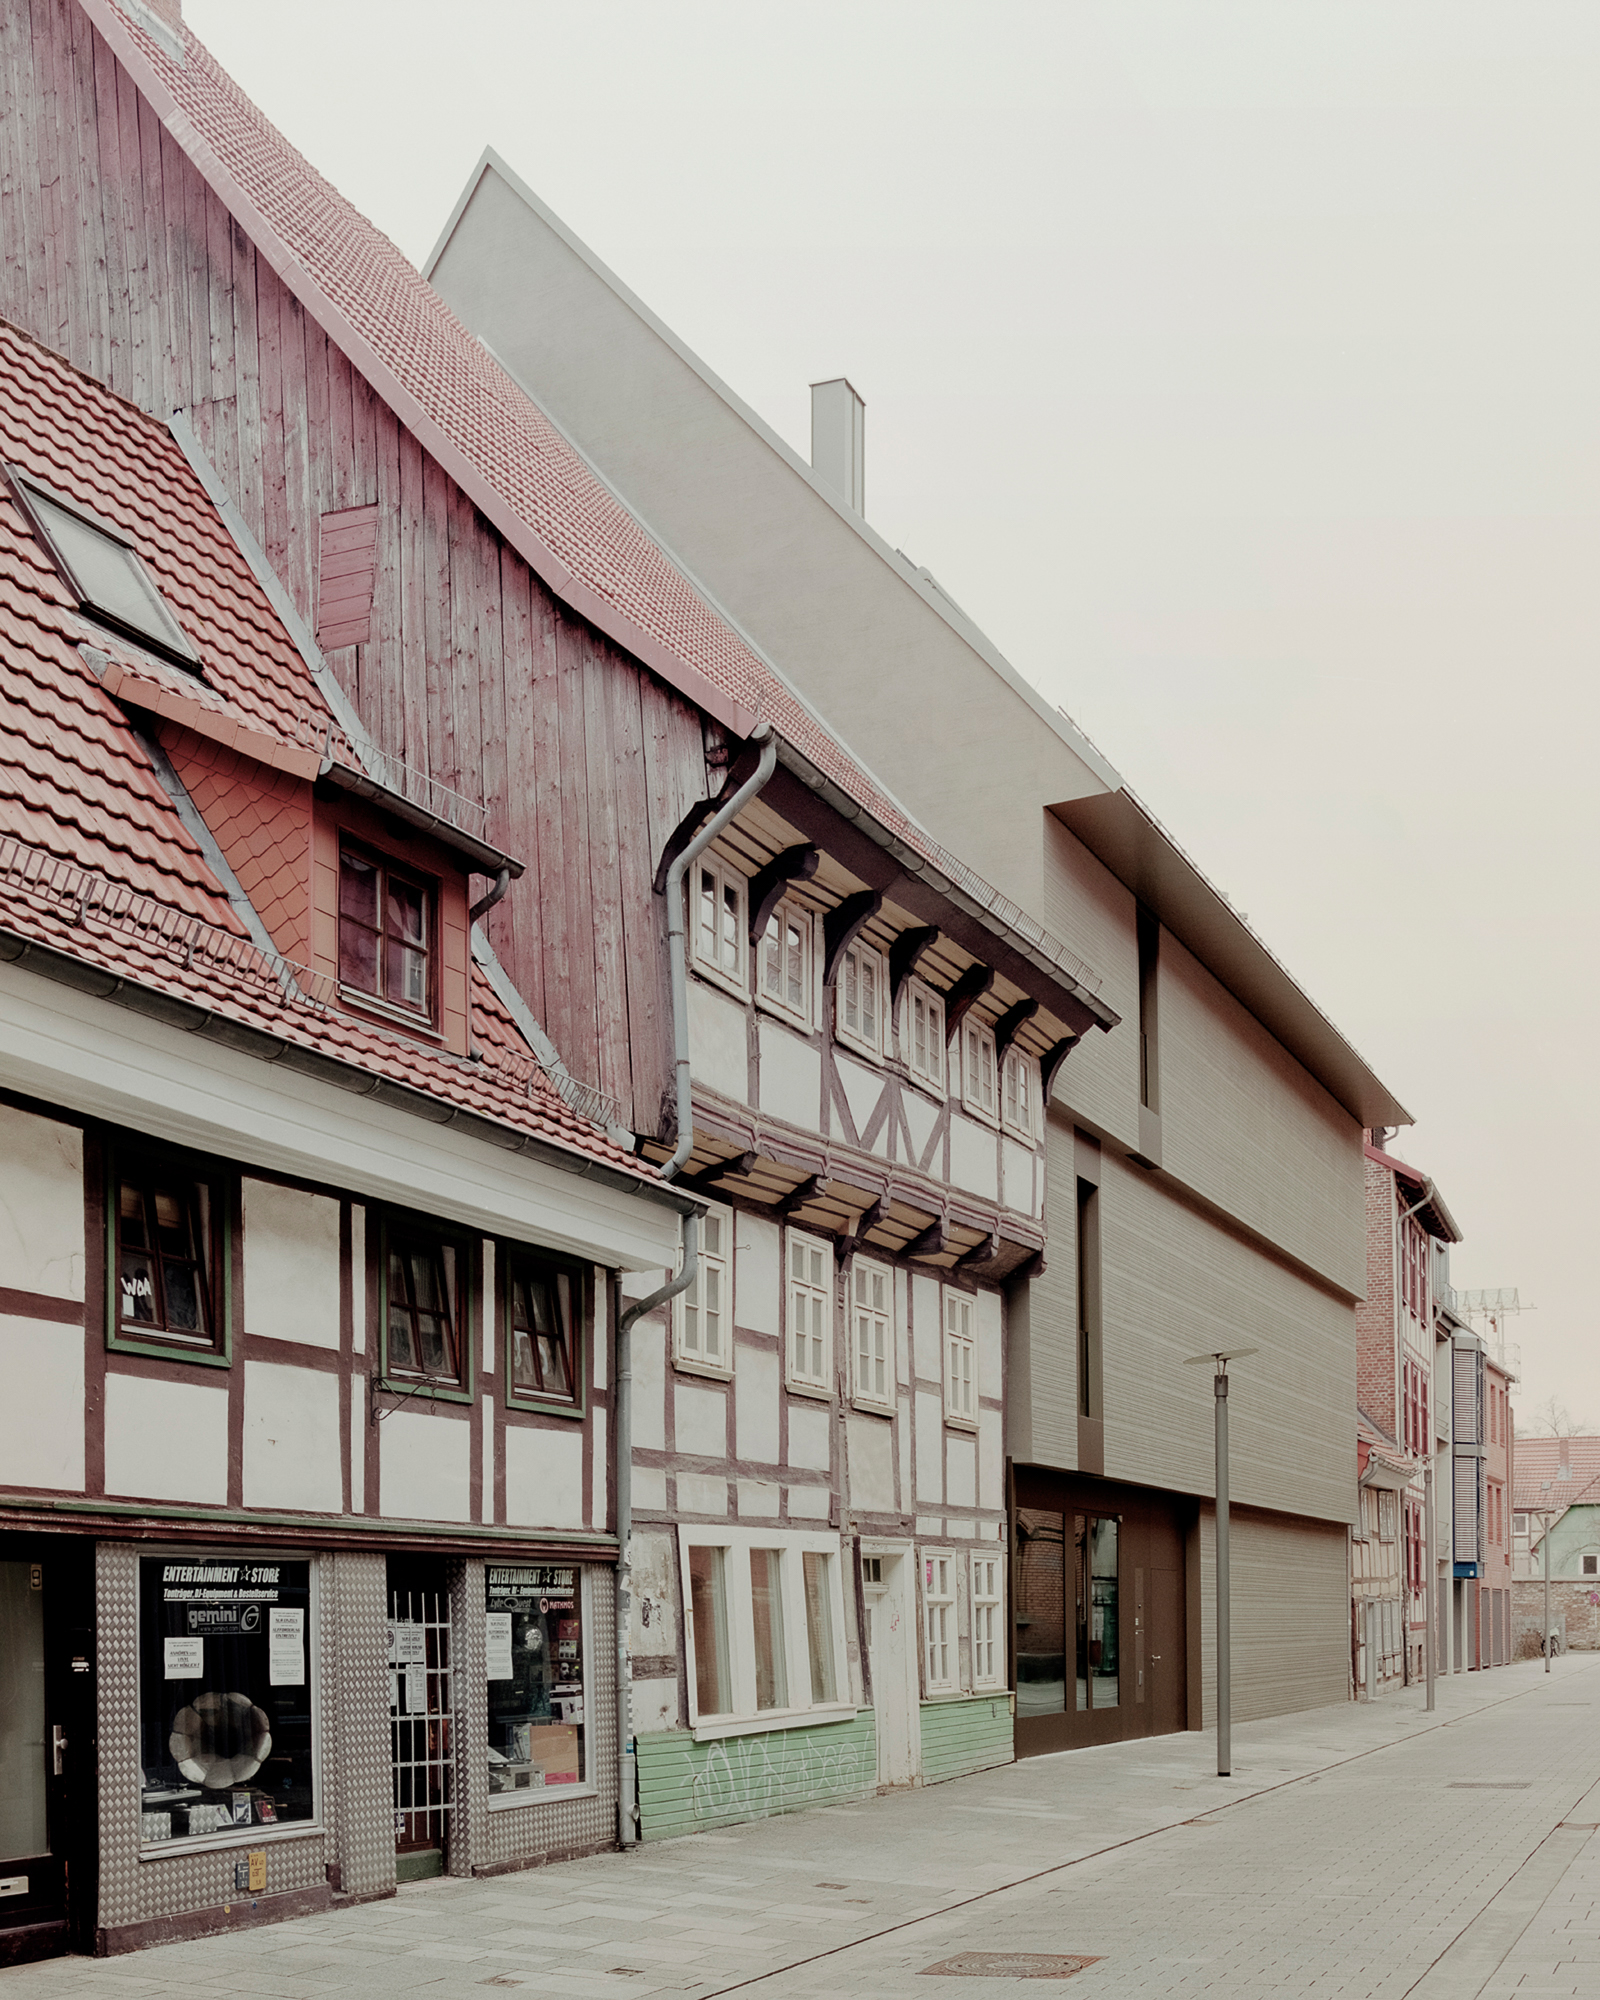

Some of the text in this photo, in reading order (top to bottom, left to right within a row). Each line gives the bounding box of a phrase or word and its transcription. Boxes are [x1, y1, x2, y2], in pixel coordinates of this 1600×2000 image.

[32, 1569, 41, 1588] 9
[163, 1566, 280, 1583] ENTERTAINMENT STORE
[489, 1568, 574, 1585] ENTERTAINMENT STORE
[239, 1588, 279, 1599] Bestellservice
[188, 1605, 238, 1629] gemini
